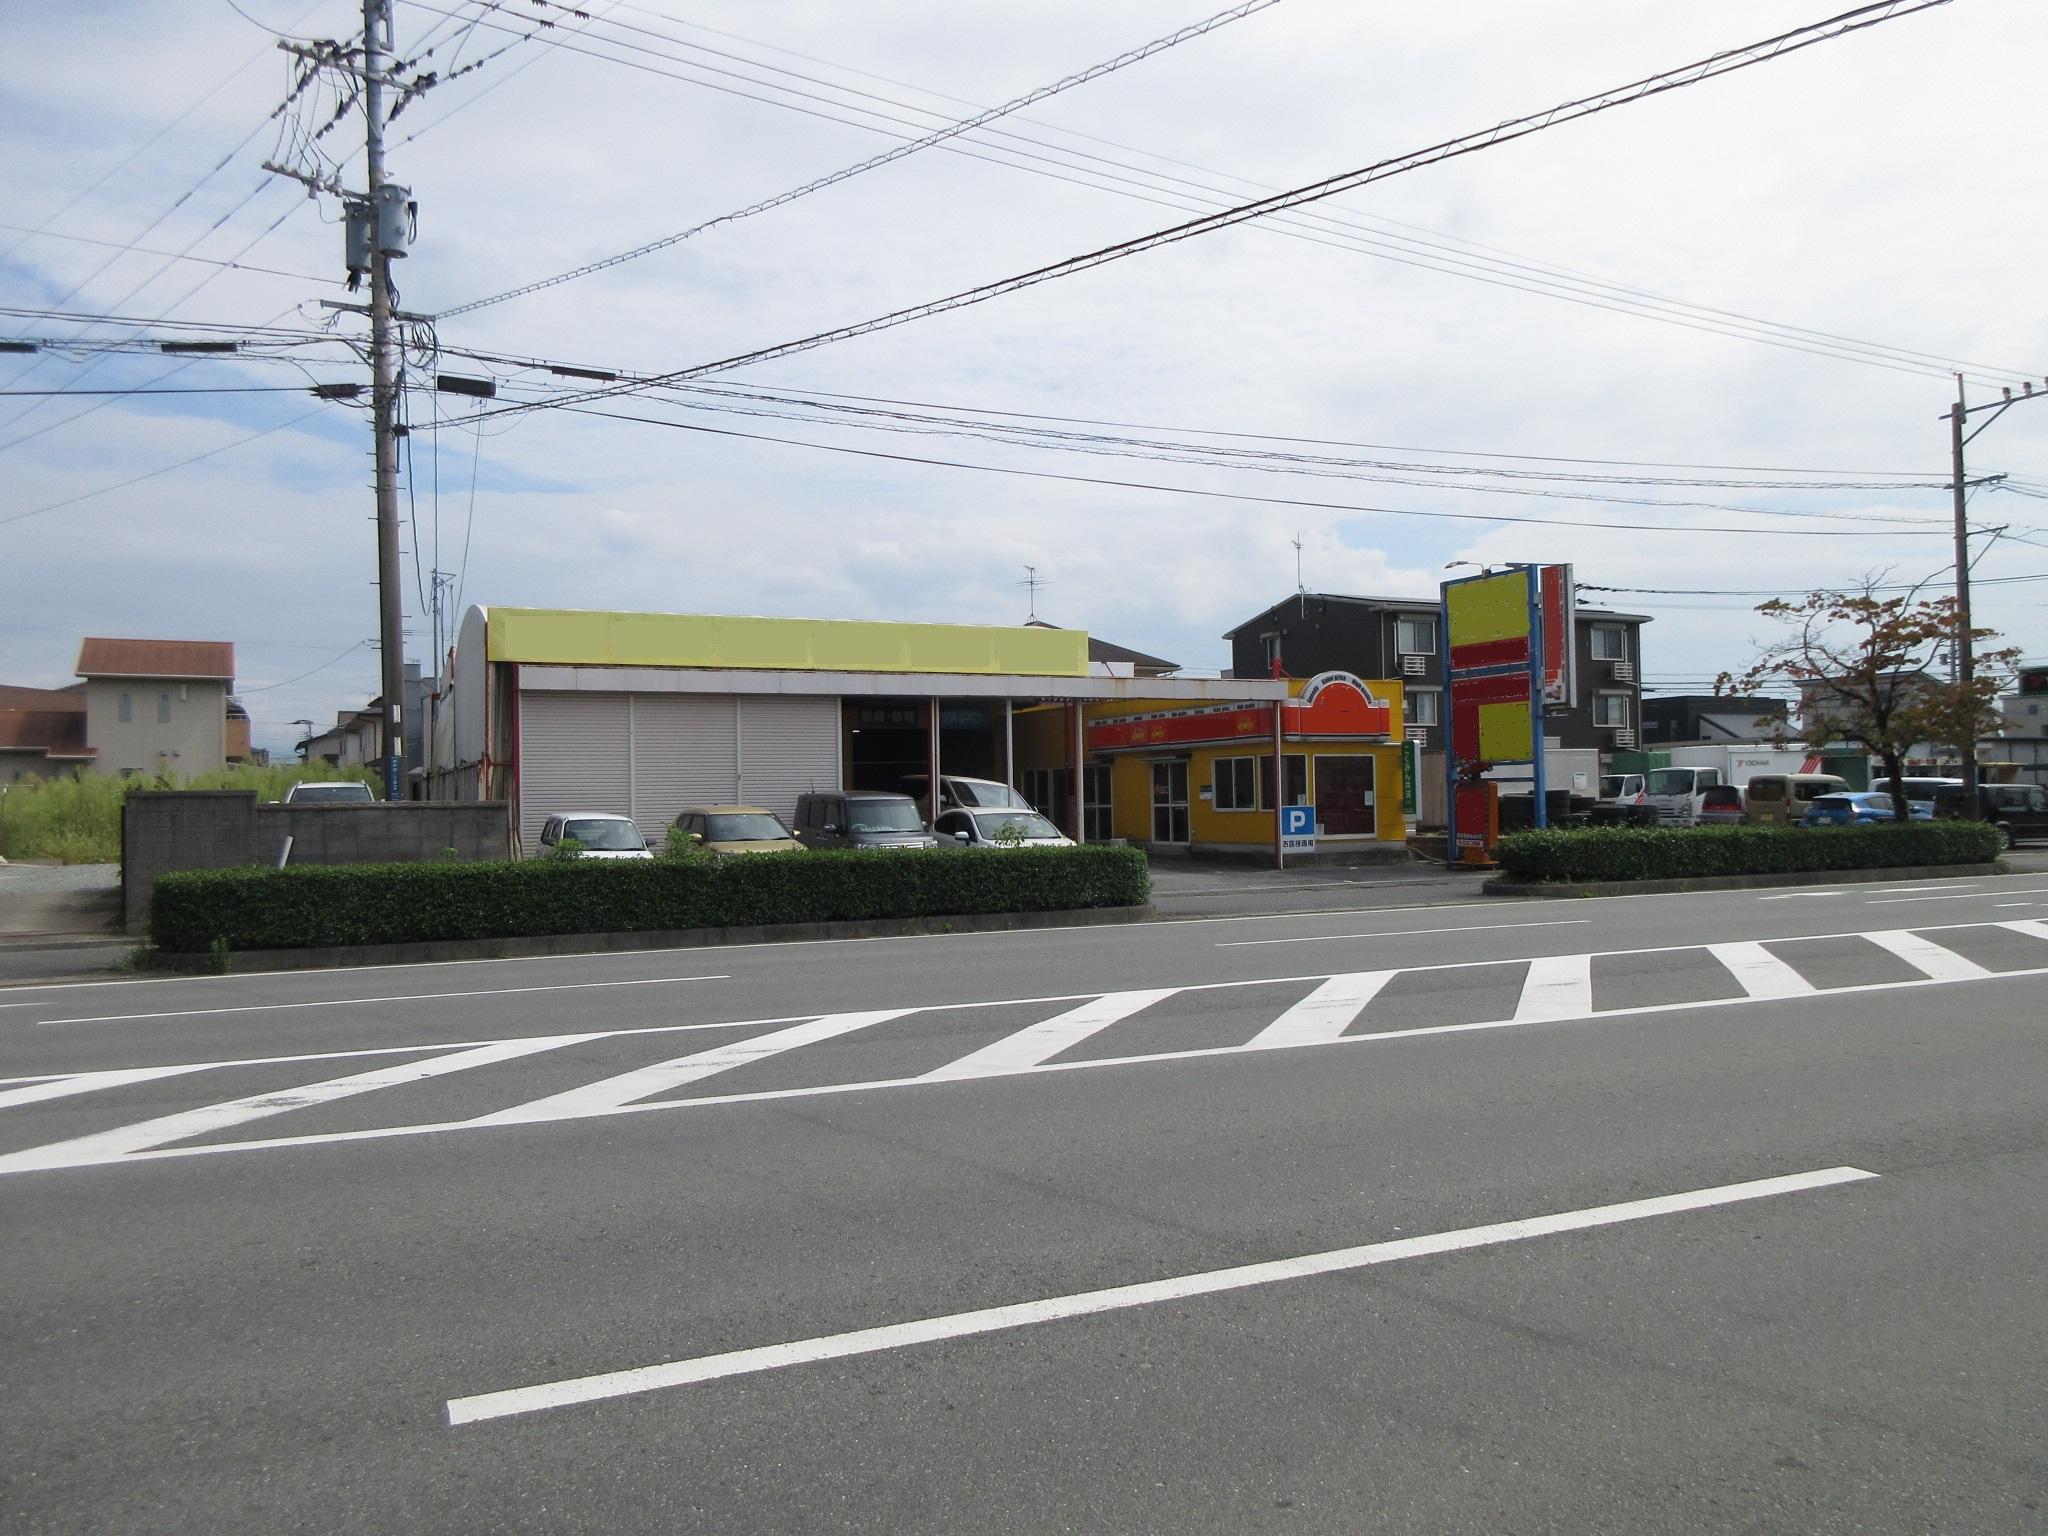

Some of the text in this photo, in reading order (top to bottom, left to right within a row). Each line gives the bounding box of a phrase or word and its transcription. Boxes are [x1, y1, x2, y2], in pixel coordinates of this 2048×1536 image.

[1290, 811, 1306, 833] P
[1282, 839, 1314, 848] お客様専用
